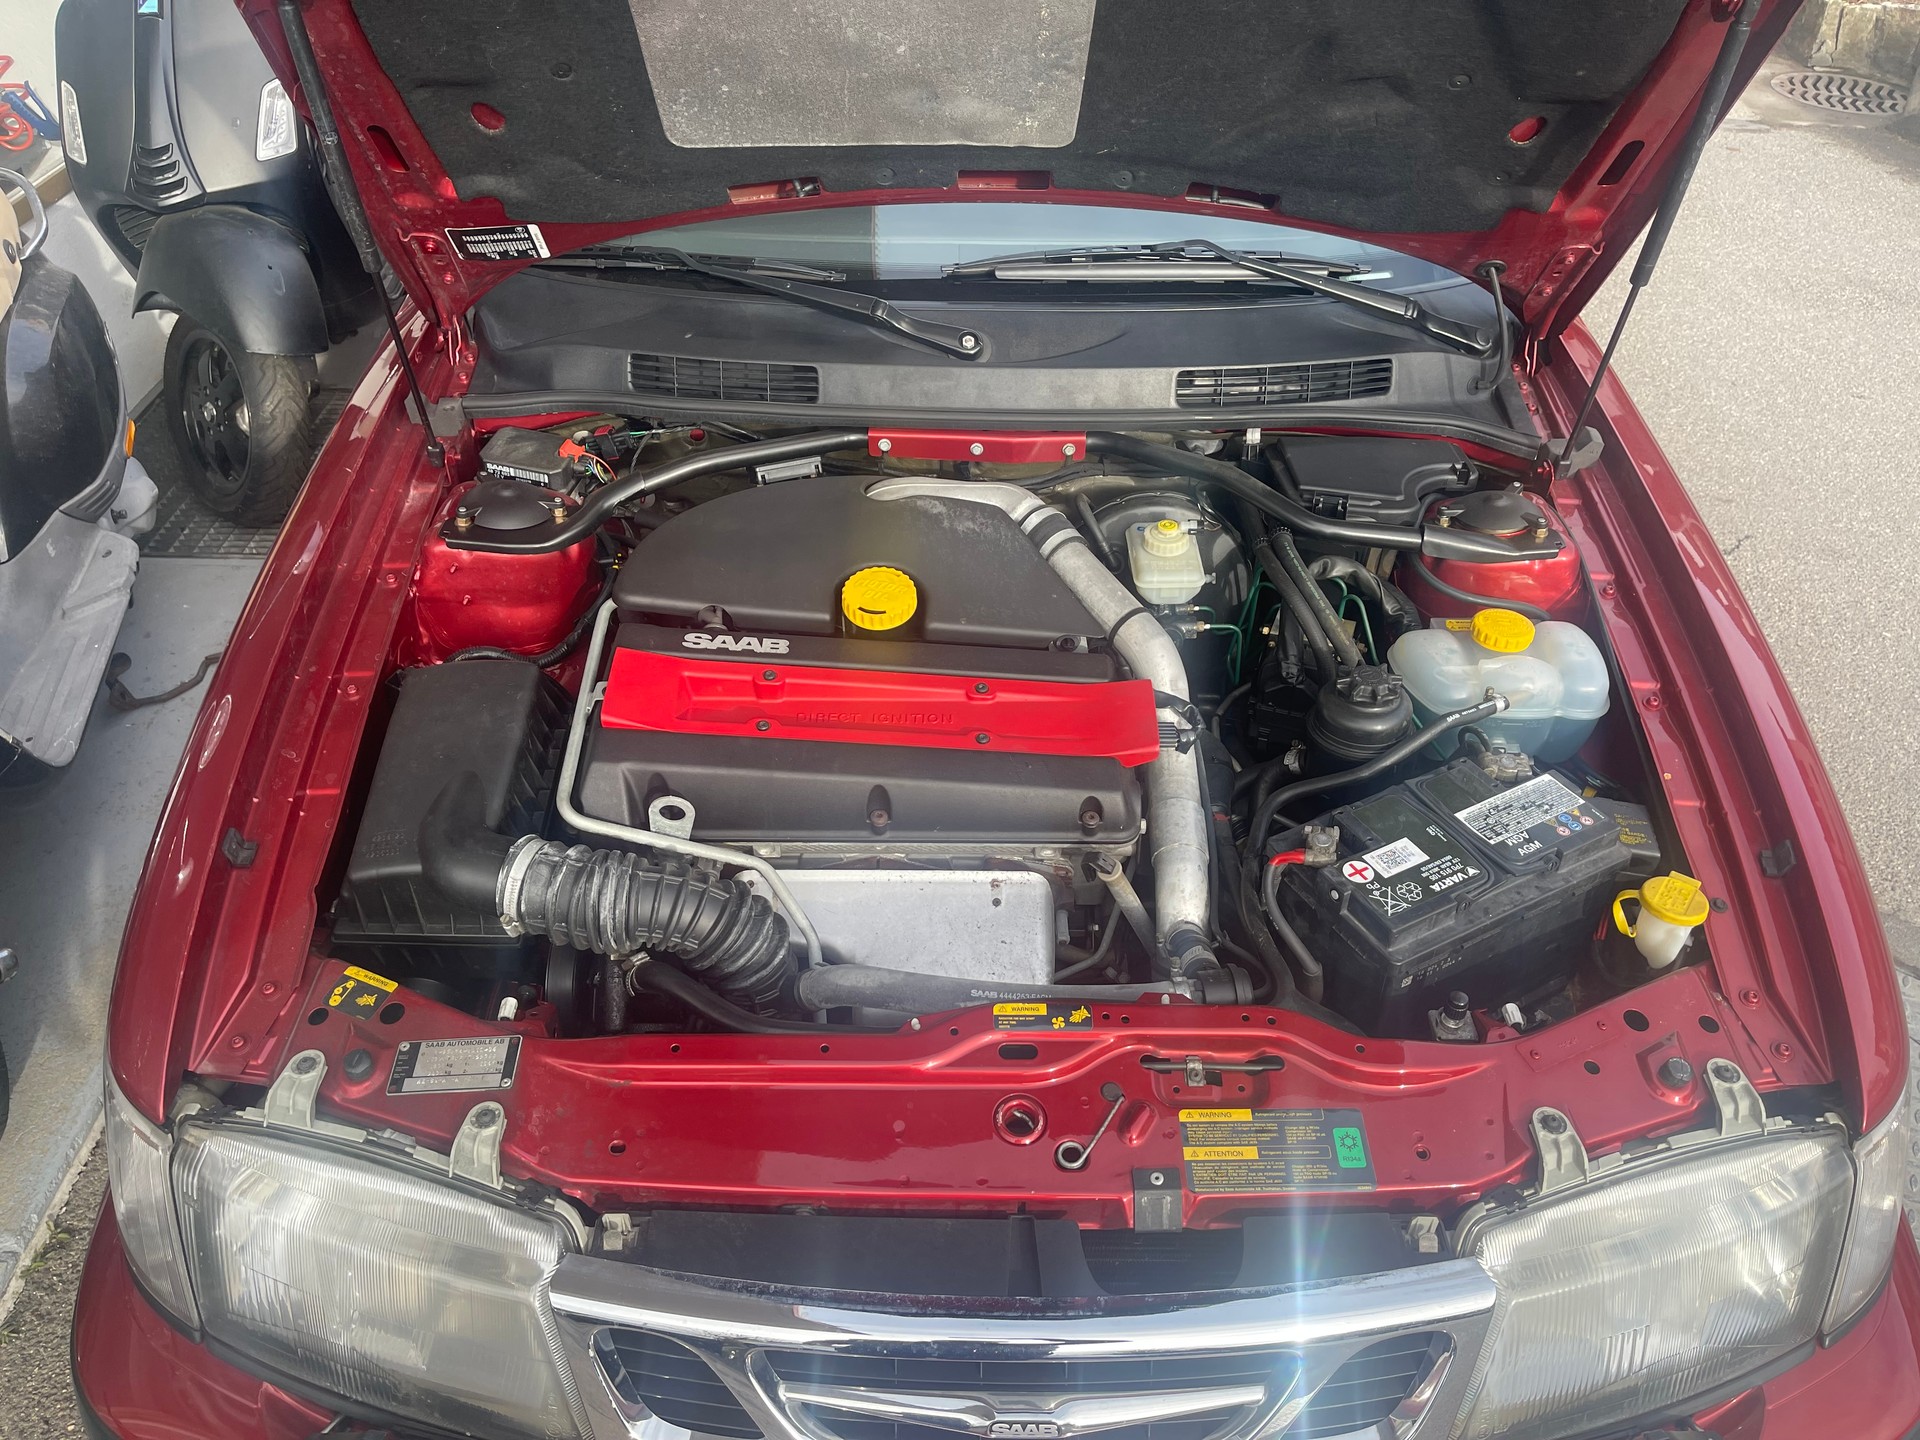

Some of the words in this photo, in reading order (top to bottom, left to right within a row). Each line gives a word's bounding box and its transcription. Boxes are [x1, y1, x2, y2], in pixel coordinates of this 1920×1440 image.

[681, 633, 790, 654] SAAB
[796, 712, 861, 723] DIRECT
[872, 713, 954, 725] IGNITION
[1504, 830, 1529, 846] AGM
[1518, 840, 1543, 856] AGM
[1366, 881, 1380, 890] Pb
[1429, 872, 1468, 892] VARTA
[363, 974, 389, 987] WARNING
[970, 989, 998, 999] SAAB
[425, 1041, 445, 1049] SAAB
[446, 1039, 493, 1047] AUTOMOBILE
[991, 1423, 1059, 1437] SAAB
